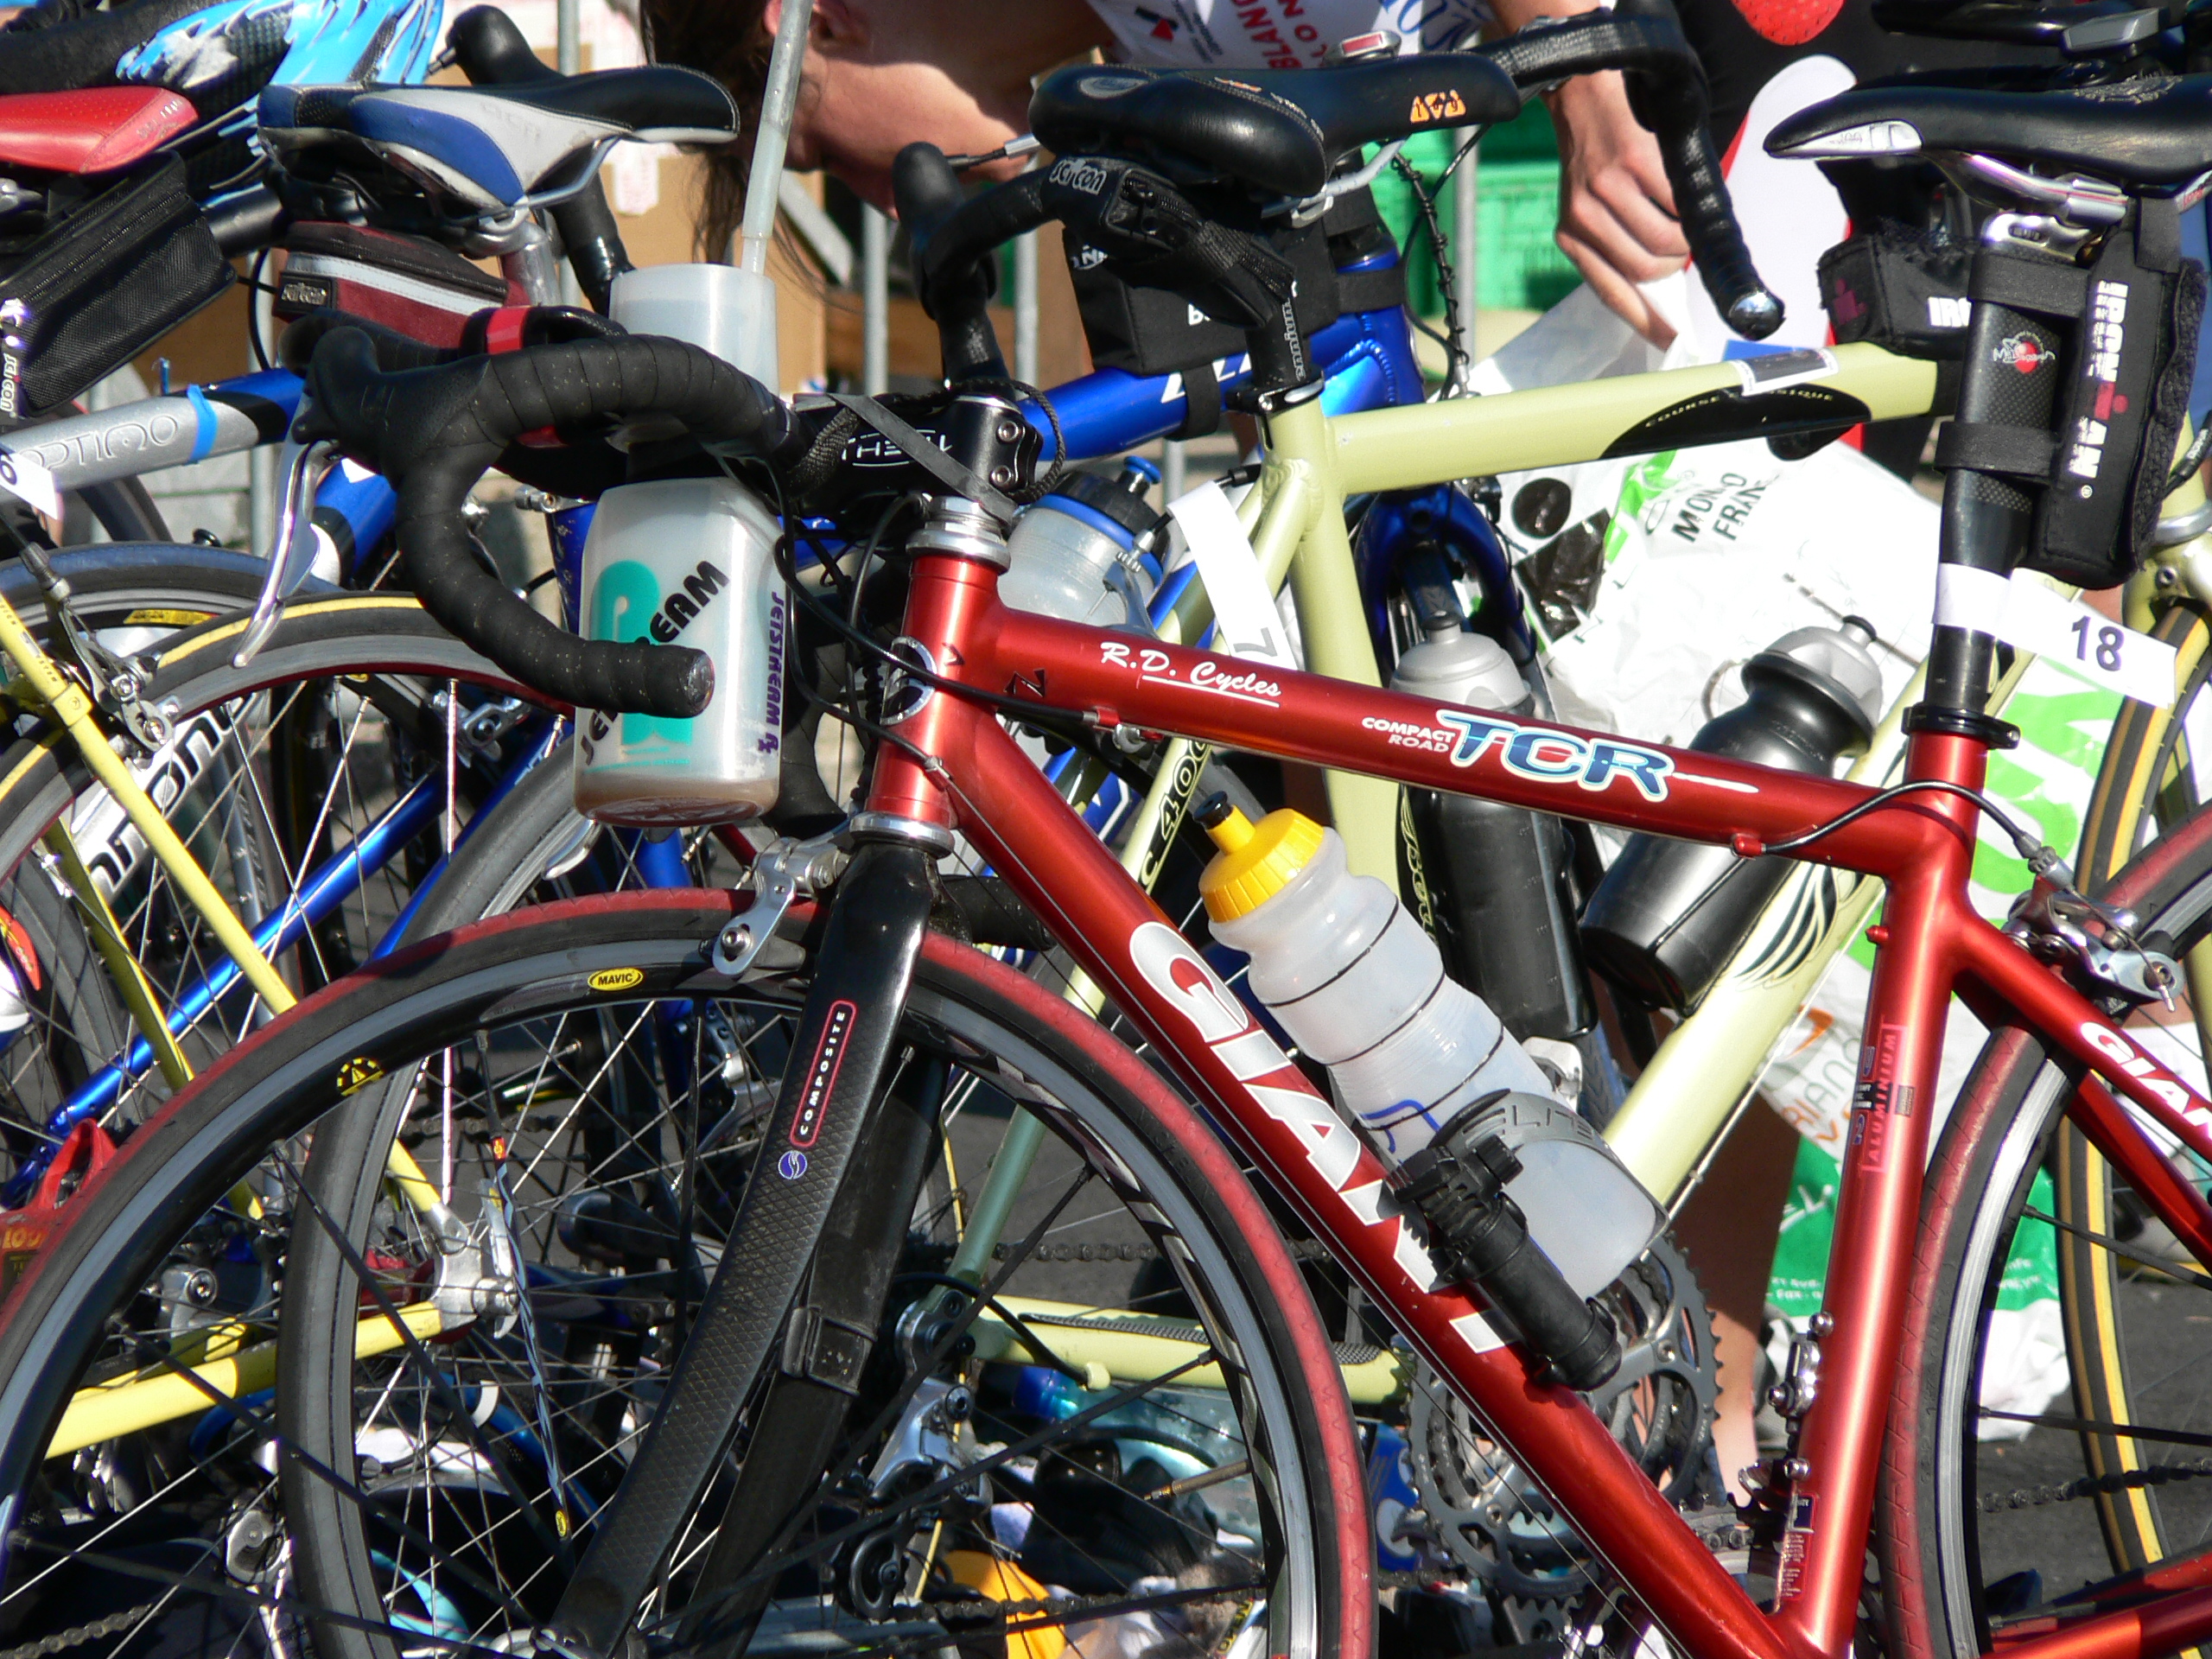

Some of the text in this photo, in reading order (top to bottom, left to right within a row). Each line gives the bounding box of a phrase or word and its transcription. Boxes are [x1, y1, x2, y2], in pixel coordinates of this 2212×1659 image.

[1231, 0, 1303, 68] BLAN
[766, 591, 785, 727] JETSTREAM
[1100, 641, 1281, 697] R.D. Cycles
[2071, 615, 2125, 671] 18
[1362, 717, 1456, 744] COMPACT
[1388, 734, 1449, 753] ROAD
[1435, 709, 1675, 803] TCR
[598, 973, 633, 986] MAVIC
[800, 1011, 846, 1135] COMPOSITE
